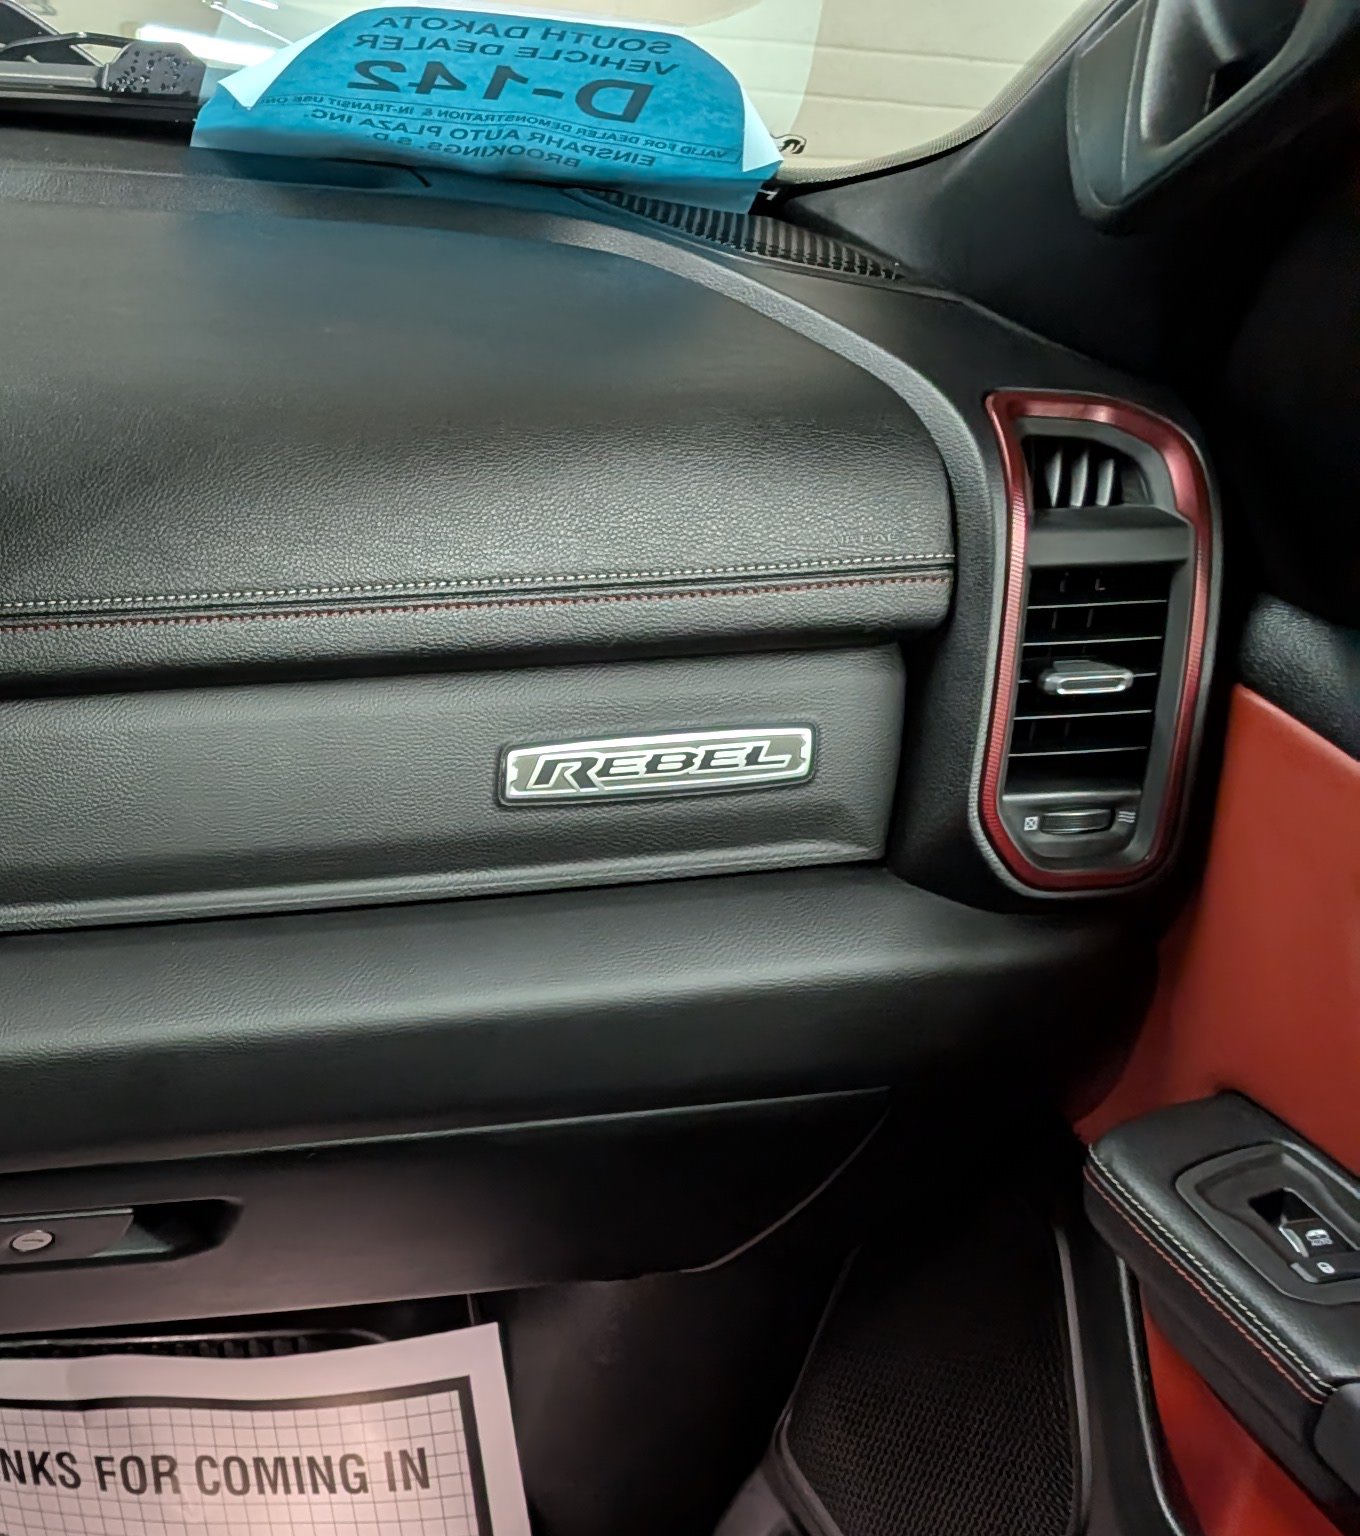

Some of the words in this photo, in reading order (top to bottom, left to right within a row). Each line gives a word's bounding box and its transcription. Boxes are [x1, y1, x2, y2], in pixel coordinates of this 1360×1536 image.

[526, 740, 793, 792] REBEL
[93, 1453, 181, 1496] FOR
[194, 1453, 370, 1496] COMING
[384, 1447, 431, 1493] IN
